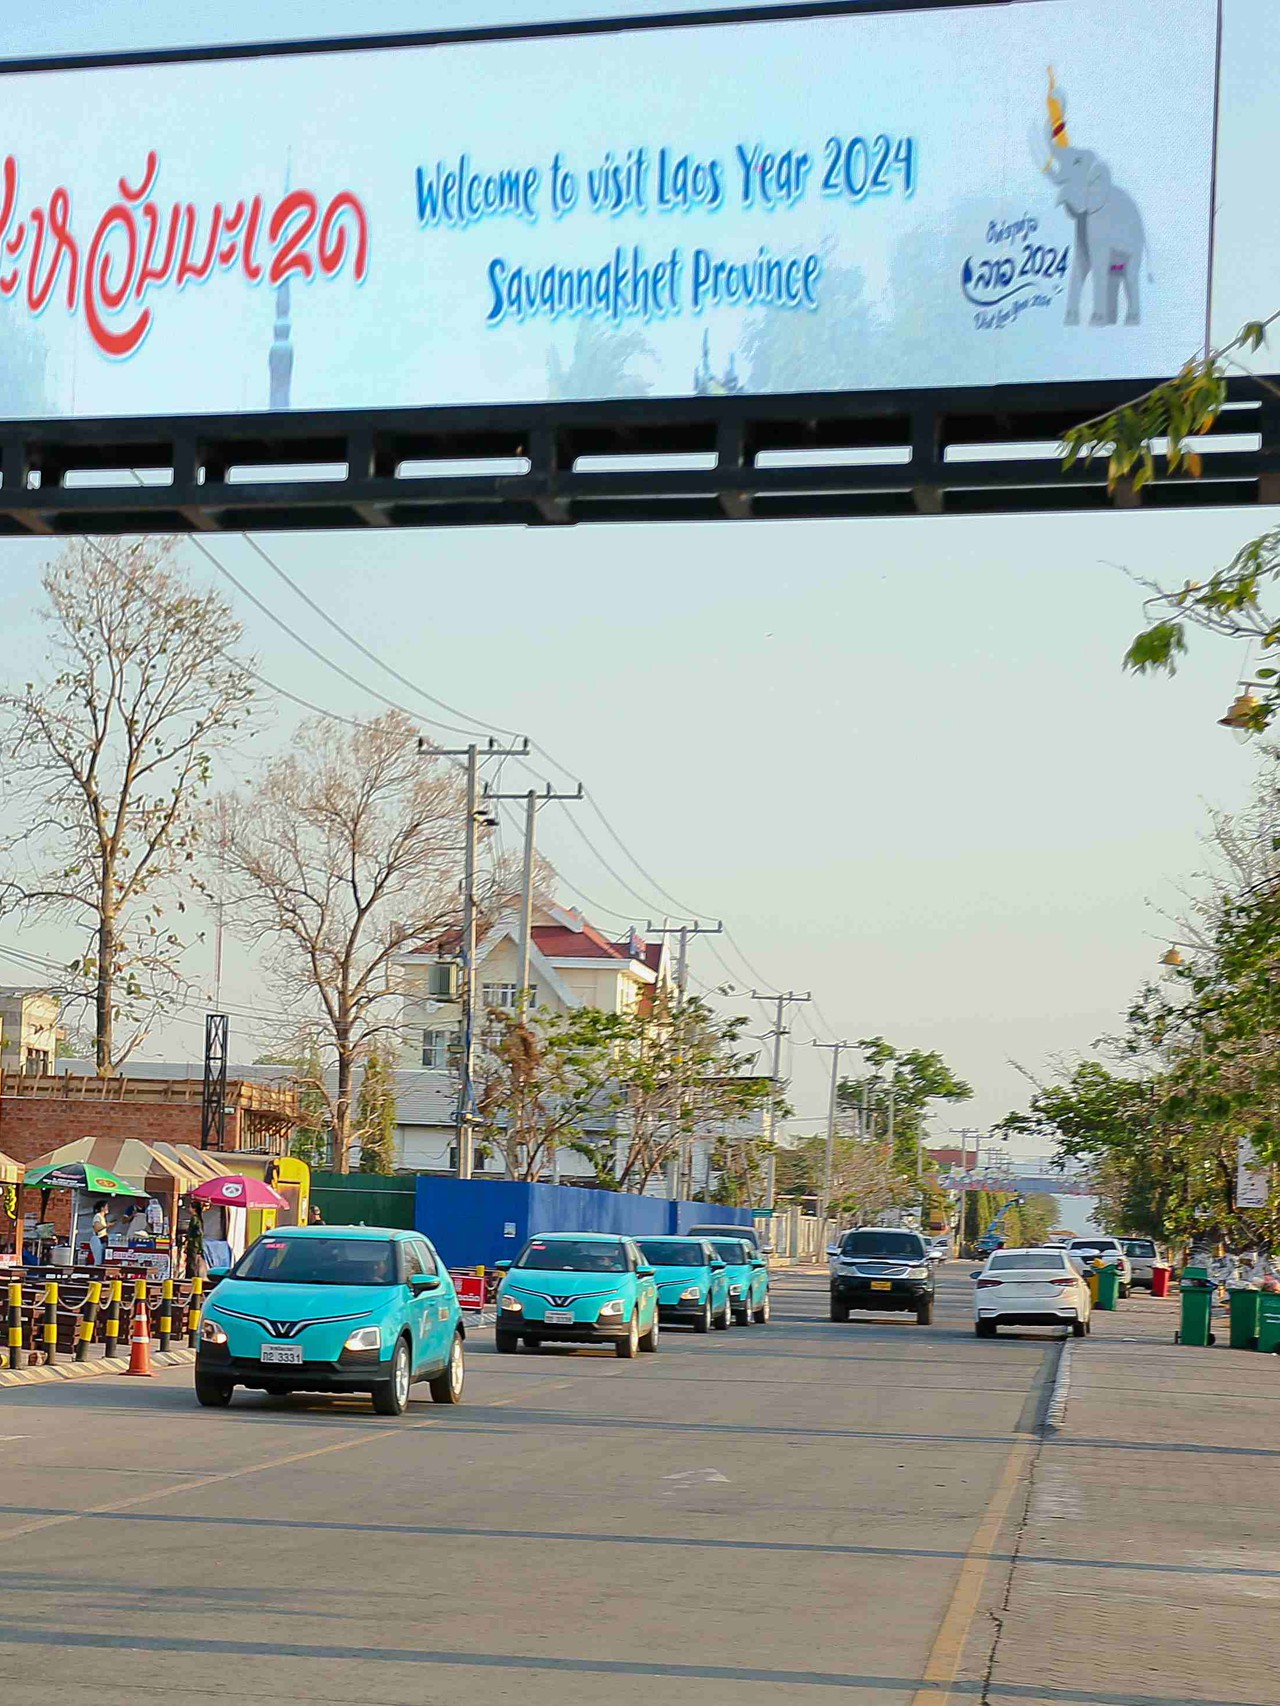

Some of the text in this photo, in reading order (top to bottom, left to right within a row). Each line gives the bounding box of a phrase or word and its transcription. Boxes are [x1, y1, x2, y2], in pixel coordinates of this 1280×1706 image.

[415, 134, 915, 222] Welcome to visit Laos Year 2024
[487, 245, 821, 321] Savannakhet Province
[1018, 244, 1071, 279] 2024
[278, 1353, 300, 1362] 3331
